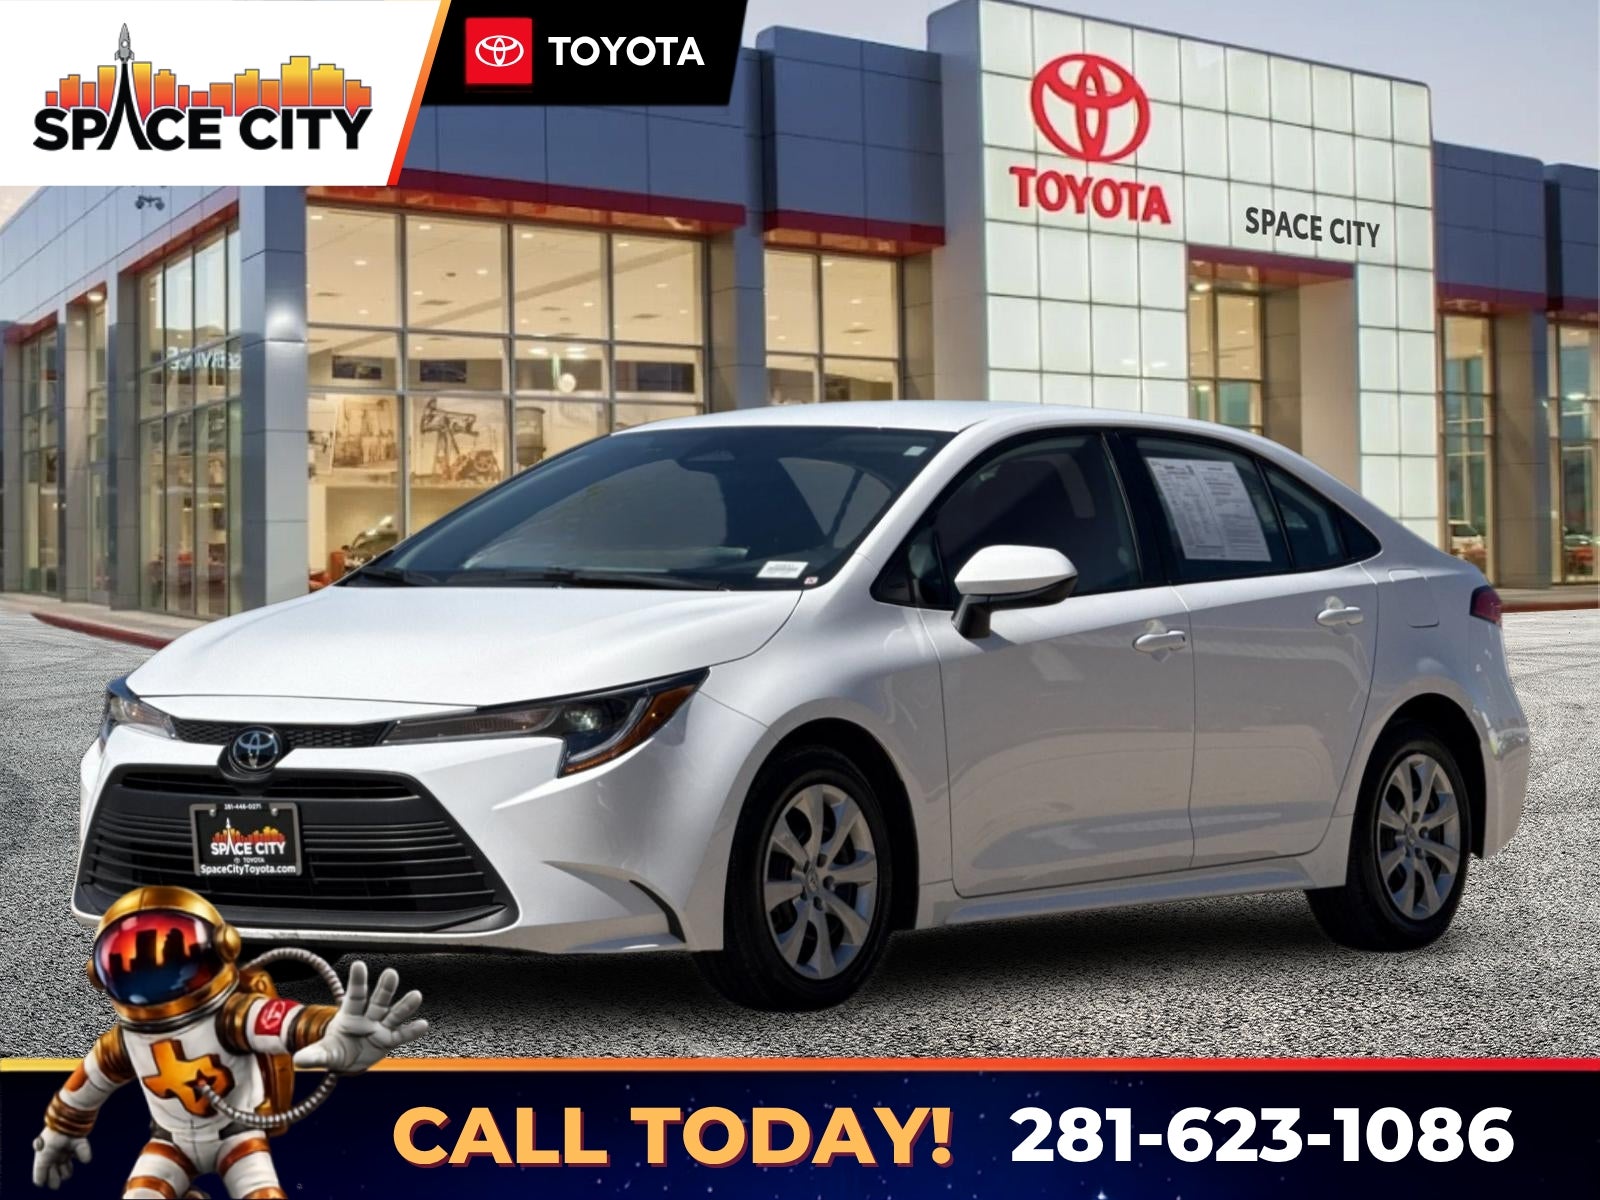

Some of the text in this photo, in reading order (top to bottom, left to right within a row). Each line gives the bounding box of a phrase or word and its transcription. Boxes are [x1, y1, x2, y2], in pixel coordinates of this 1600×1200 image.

[1009, 166, 1171, 224] TOYOTA
[1245, 206, 1381, 248] SPACE CITY
[210, 841, 287, 855] SPACE CITY
[200, 864, 296, 876] SpaceCityToyota.com
